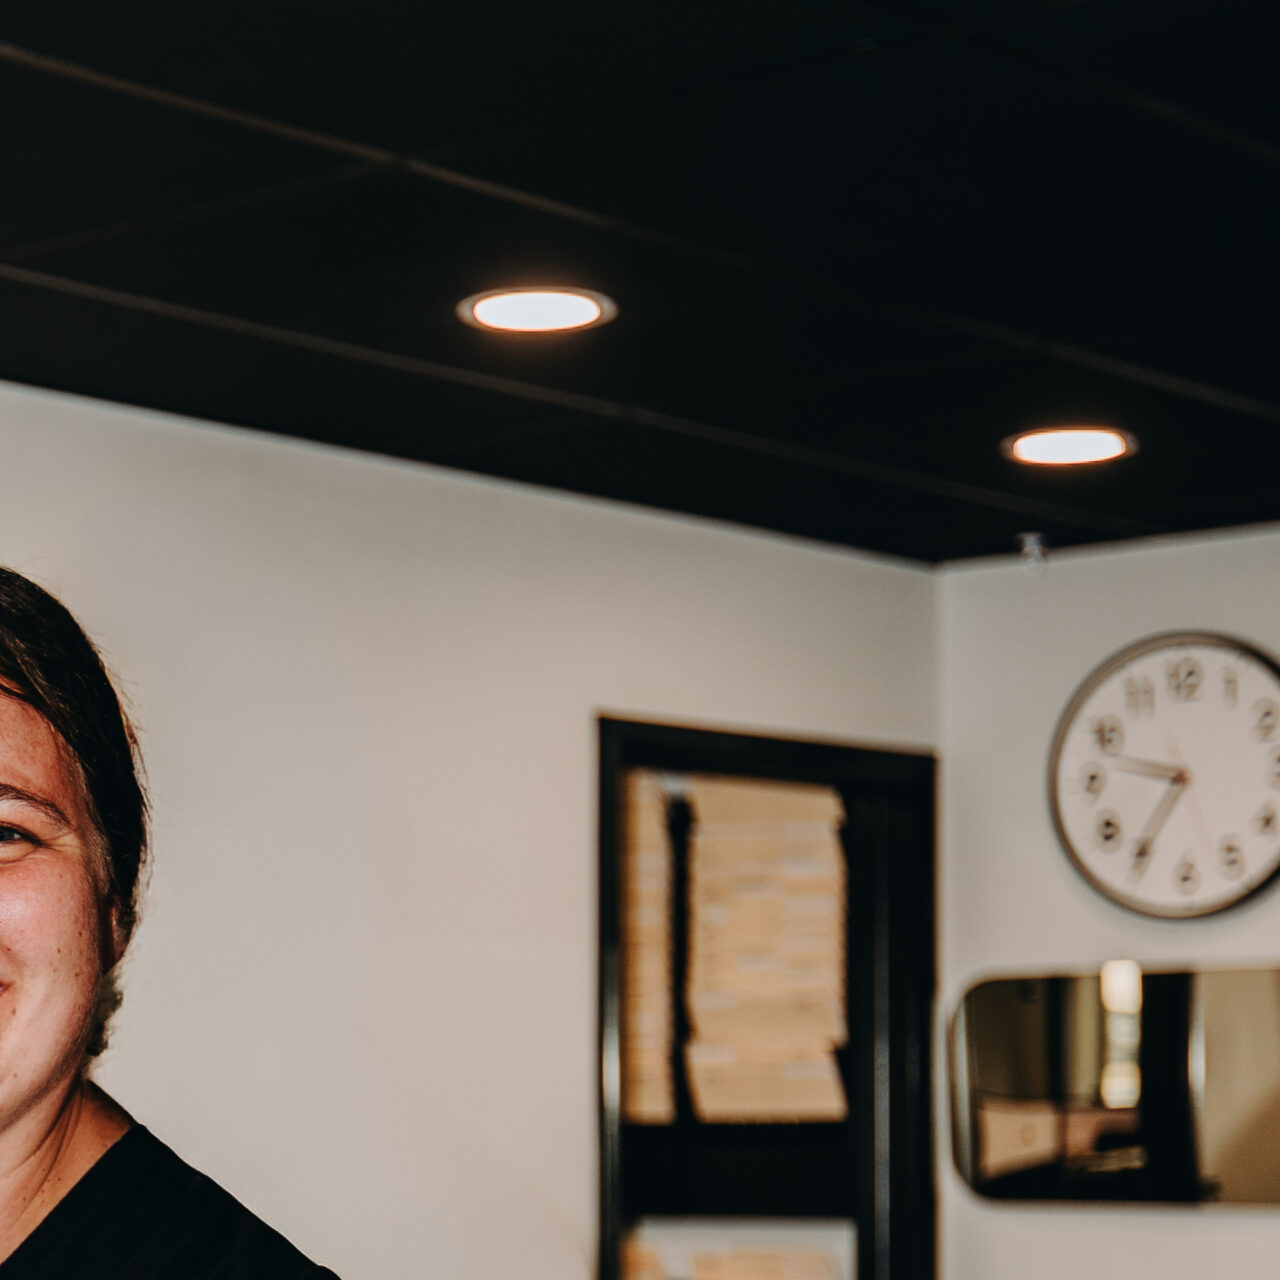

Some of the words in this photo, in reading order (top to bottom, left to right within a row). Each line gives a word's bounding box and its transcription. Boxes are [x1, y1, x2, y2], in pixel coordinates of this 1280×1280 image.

[1168, 657, 1204, 701] 12
[1080, 762, 1106, 802] 9
[1097, 809, 1120, 852] 8
